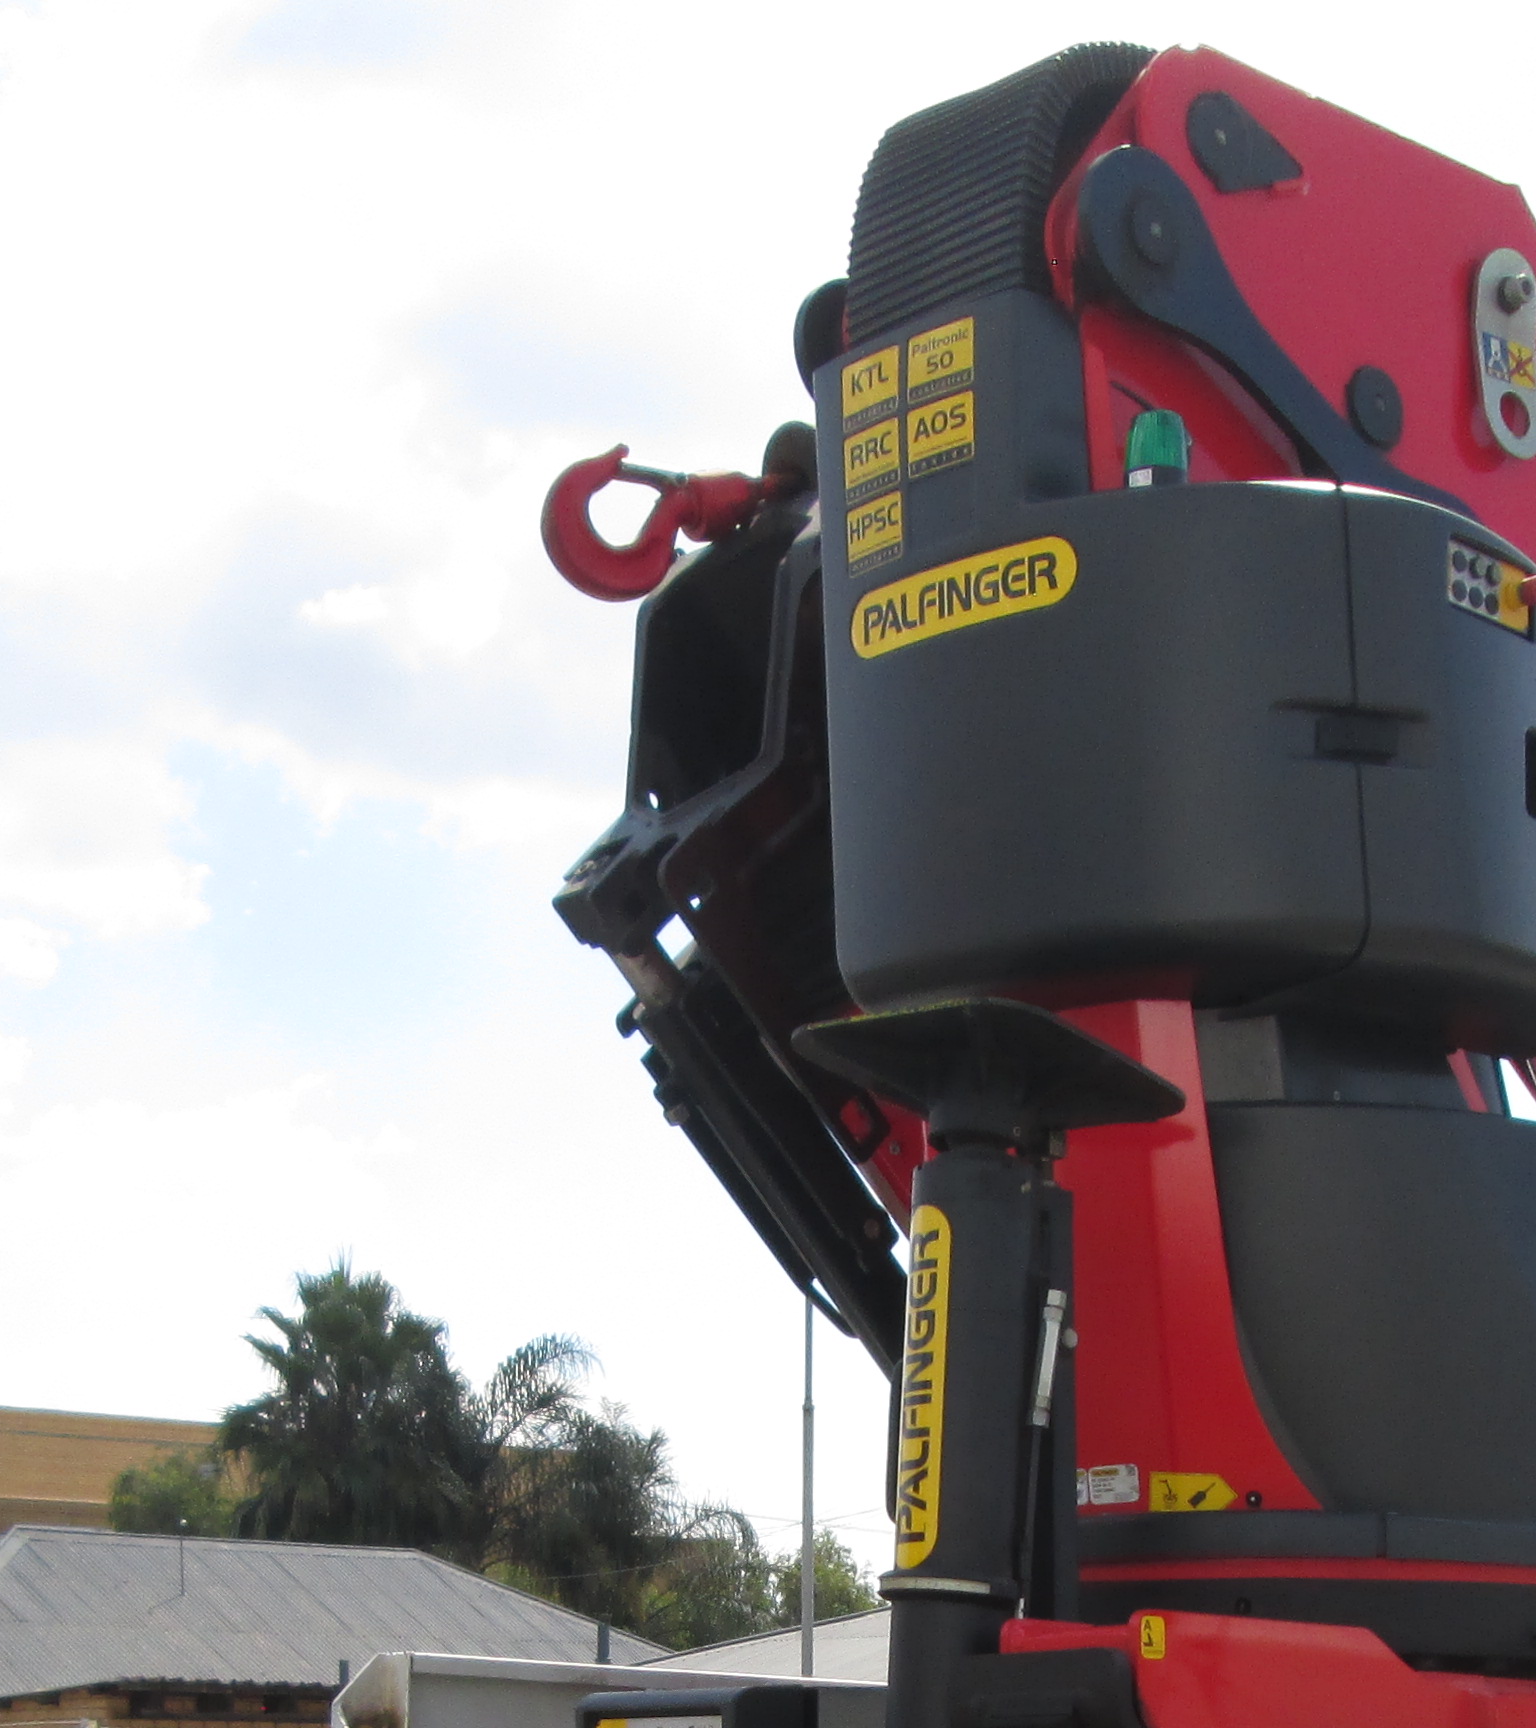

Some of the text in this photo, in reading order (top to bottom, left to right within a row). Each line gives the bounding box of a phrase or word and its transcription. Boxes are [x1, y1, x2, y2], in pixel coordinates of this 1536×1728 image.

[911, 327, 969, 358] Paltronic
[926, 350, 954, 375] 50
[850, 360, 889, 397] KTL
[913, 402, 967, 443] AOS
[849, 430, 892, 470] RRC
[848, 501, 899, 545] HPSC
[862, 550, 1059, 646] PALFINGER
[897, 1227, 940, 1544] PALFINGER
